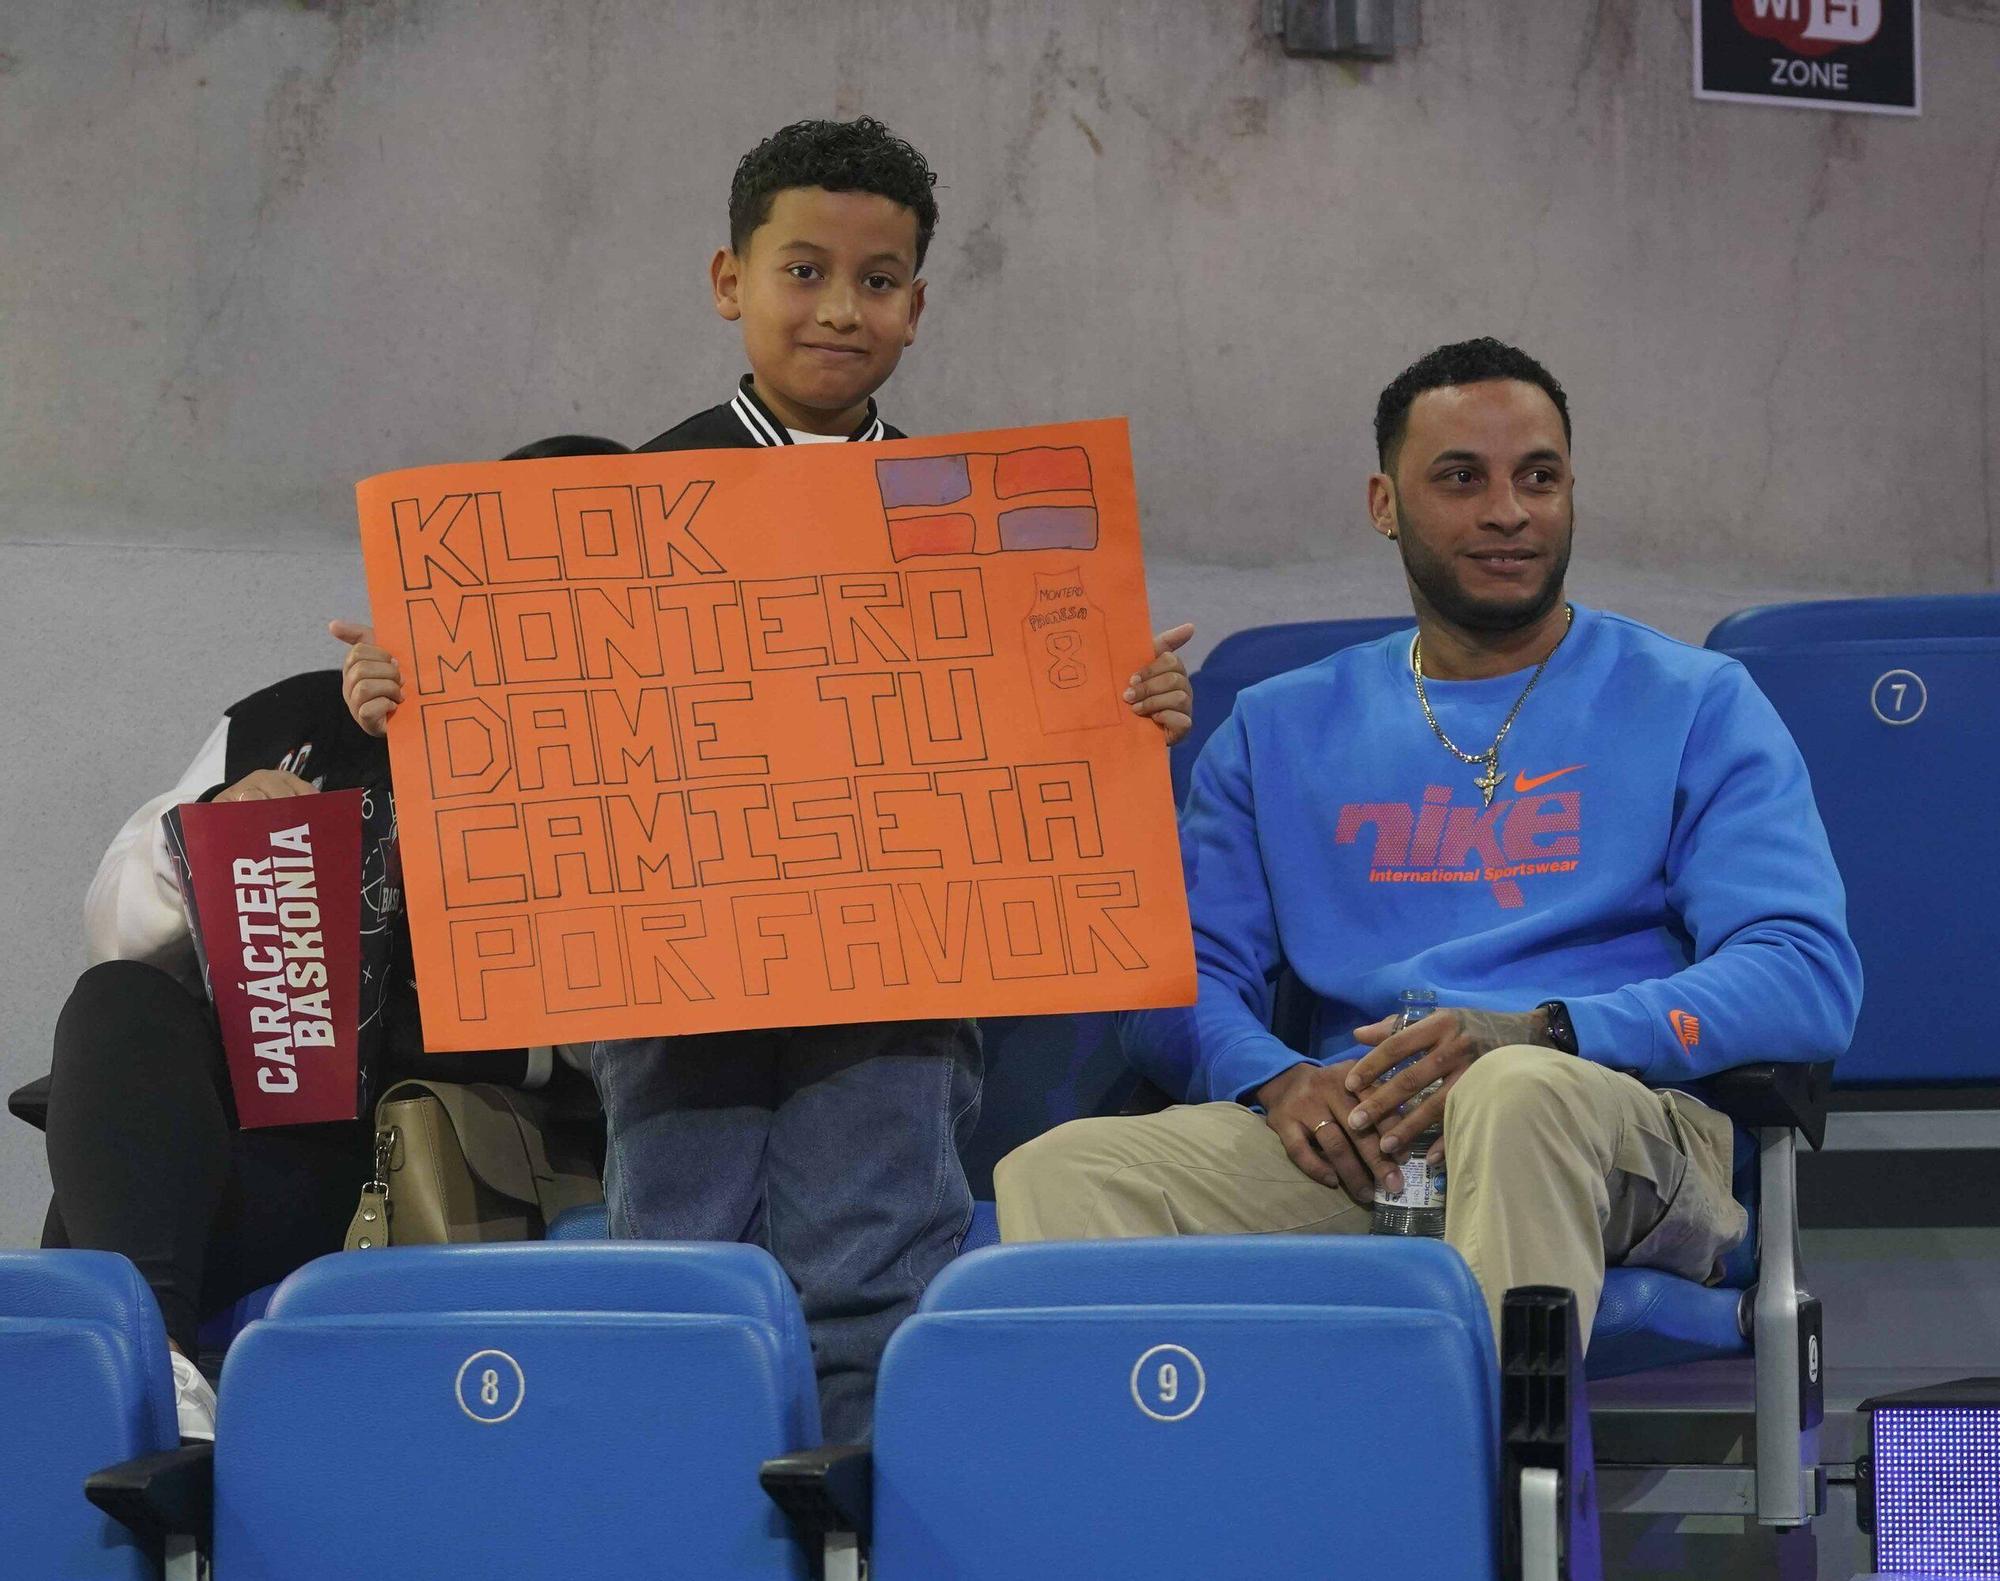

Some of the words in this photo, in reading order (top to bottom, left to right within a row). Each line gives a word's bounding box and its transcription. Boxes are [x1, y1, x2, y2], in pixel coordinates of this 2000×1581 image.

[1770, 58, 1849, 90] ZONE
[391, 480, 727, 591] KLOK
[406, 567, 994, 696] MONTERO
[1039, 585, 1084, 602] MONTERO
[1045, 629, 1088, 690] 8
[1891, 683, 1907, 711] 7
[420, 681, 770, 800] DAME
[816, 667, 989, 767] TU
[434, 760, 1104, 911] CAMISETA
[1369, 867, 1480, 882] International
[1484, 859, 1579, 881] Sportswear
[231, 855, 299, 1094] CARÁCTER
[269, 822, 336, 1048] BASKONIA
[449, 899, 716, 1021] POR
[731, 869, 1150, 997] FAVOR
[481, 1369, 499, 1405] 8
[1158, 1363, 1178, 1402] 9
